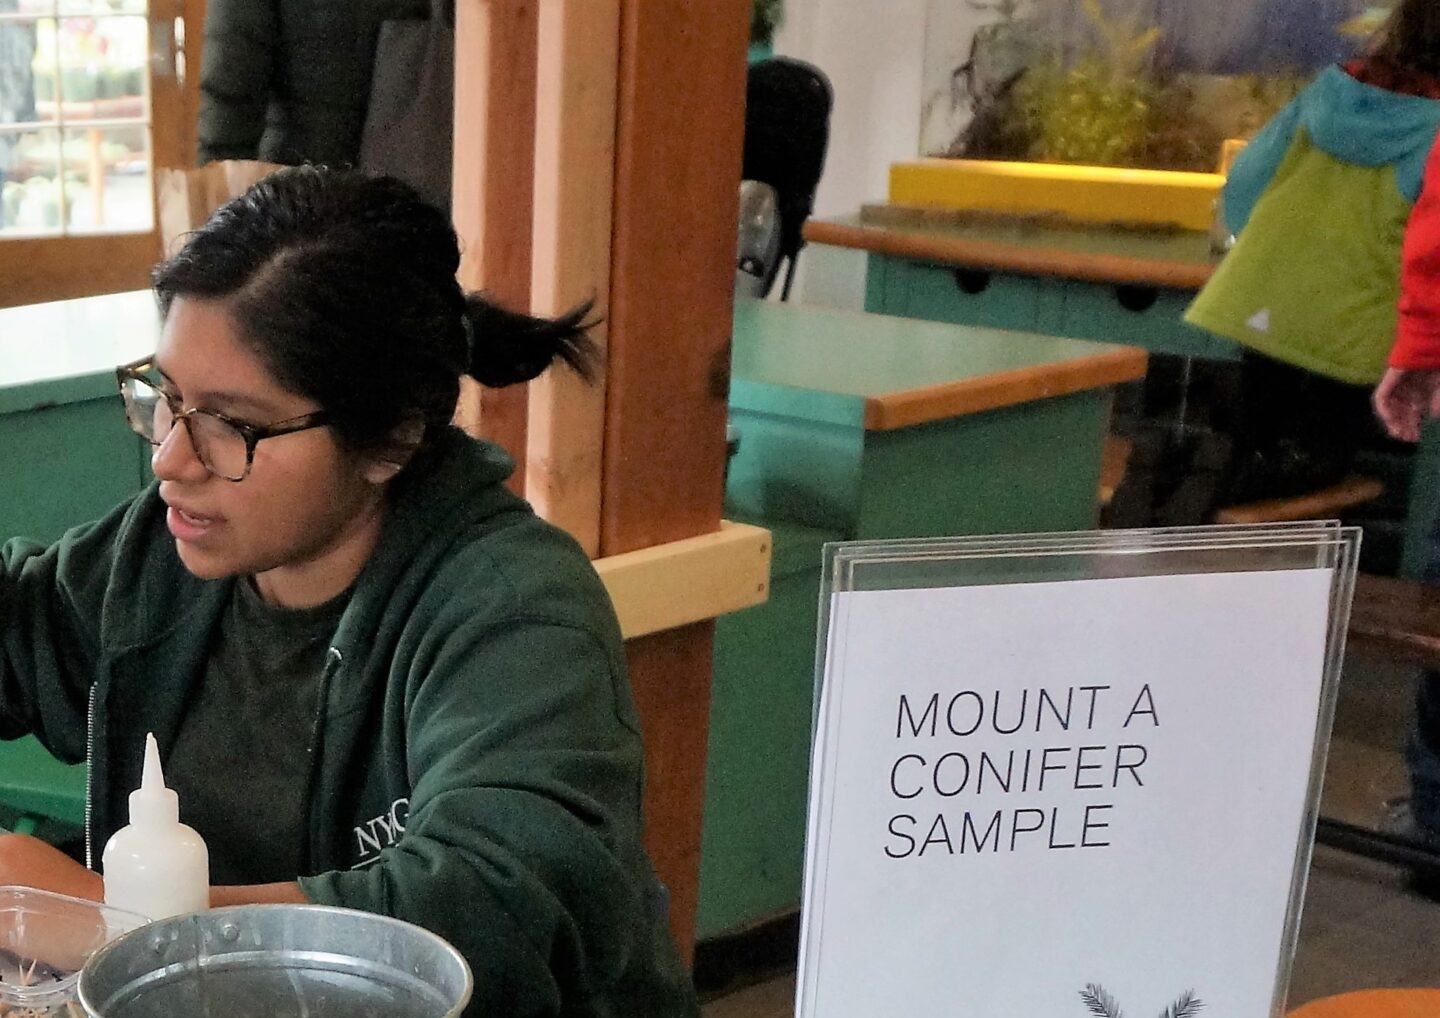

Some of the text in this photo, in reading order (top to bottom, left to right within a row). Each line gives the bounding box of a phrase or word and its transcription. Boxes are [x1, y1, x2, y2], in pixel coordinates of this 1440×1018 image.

[896, 683, 1160, 738] MOUNT A
[890, 744, 1148, 799] CONIFER
[883, 804, 1114, 859] SAMPLE
